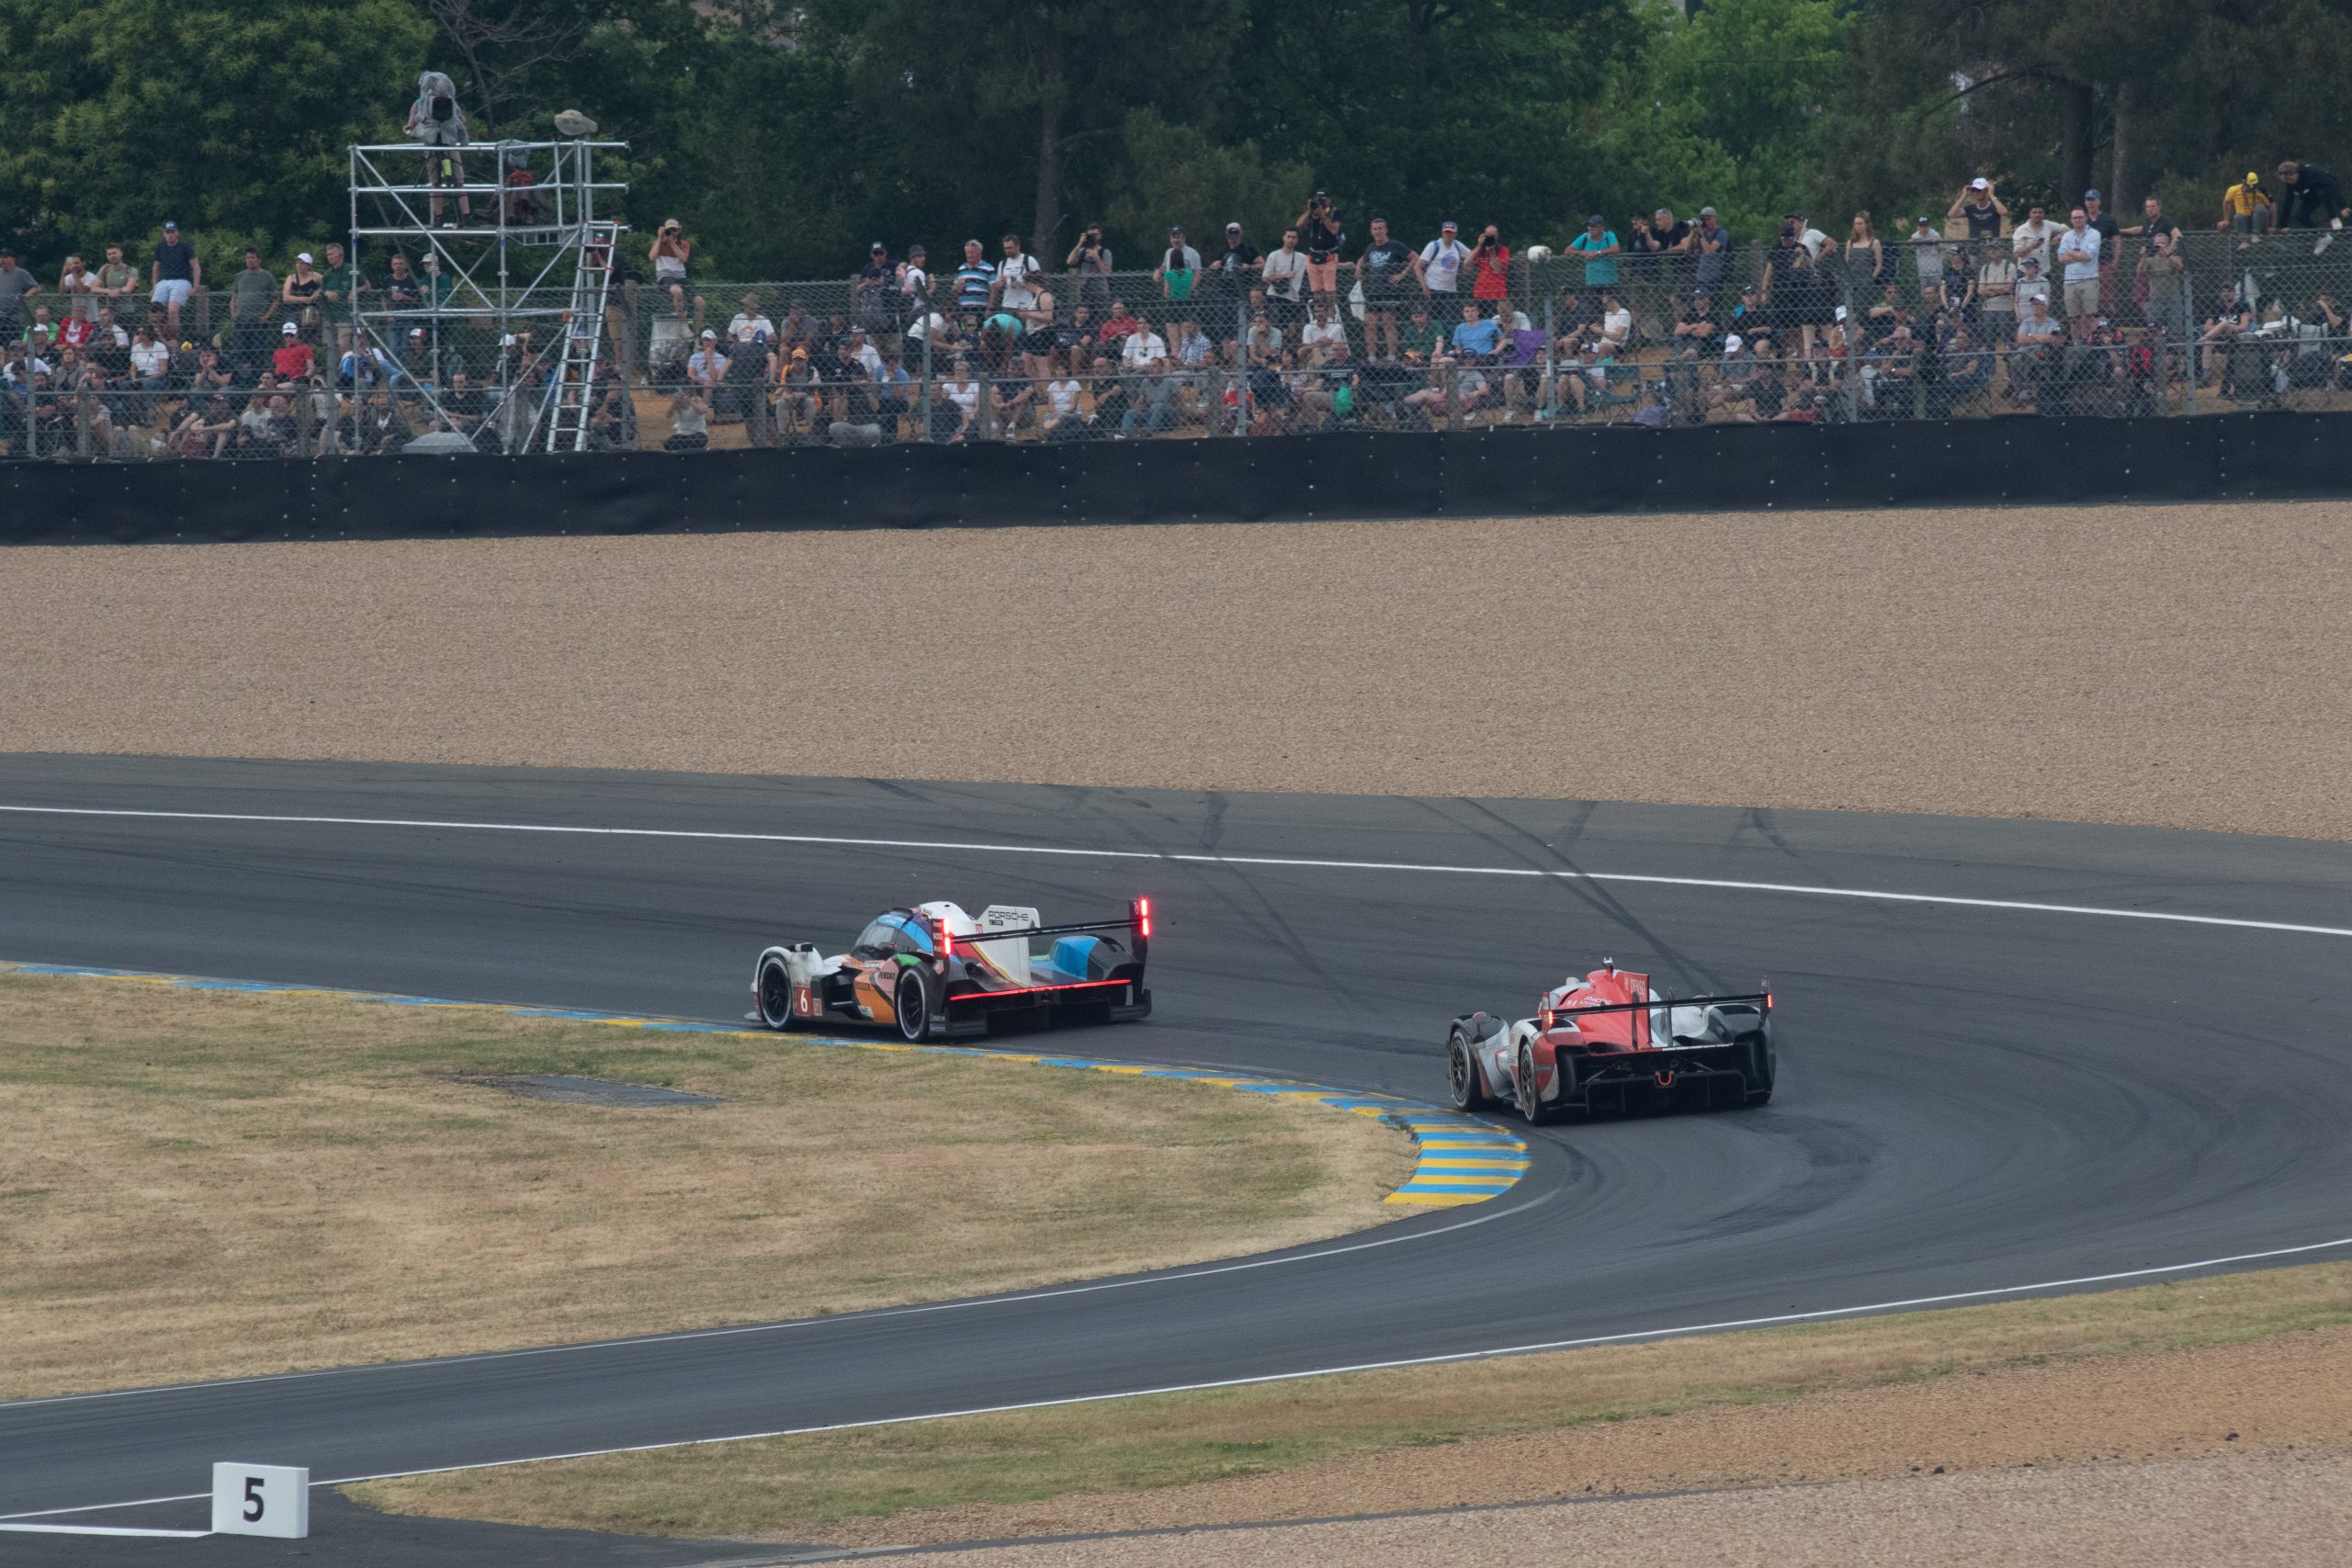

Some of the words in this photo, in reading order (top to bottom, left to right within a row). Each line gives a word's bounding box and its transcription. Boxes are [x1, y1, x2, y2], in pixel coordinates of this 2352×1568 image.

[988, 910, 1029, 921] PORSCHE
[800, 989, 808, 1013] 6
[243, 1476, 265, 1523] 5
